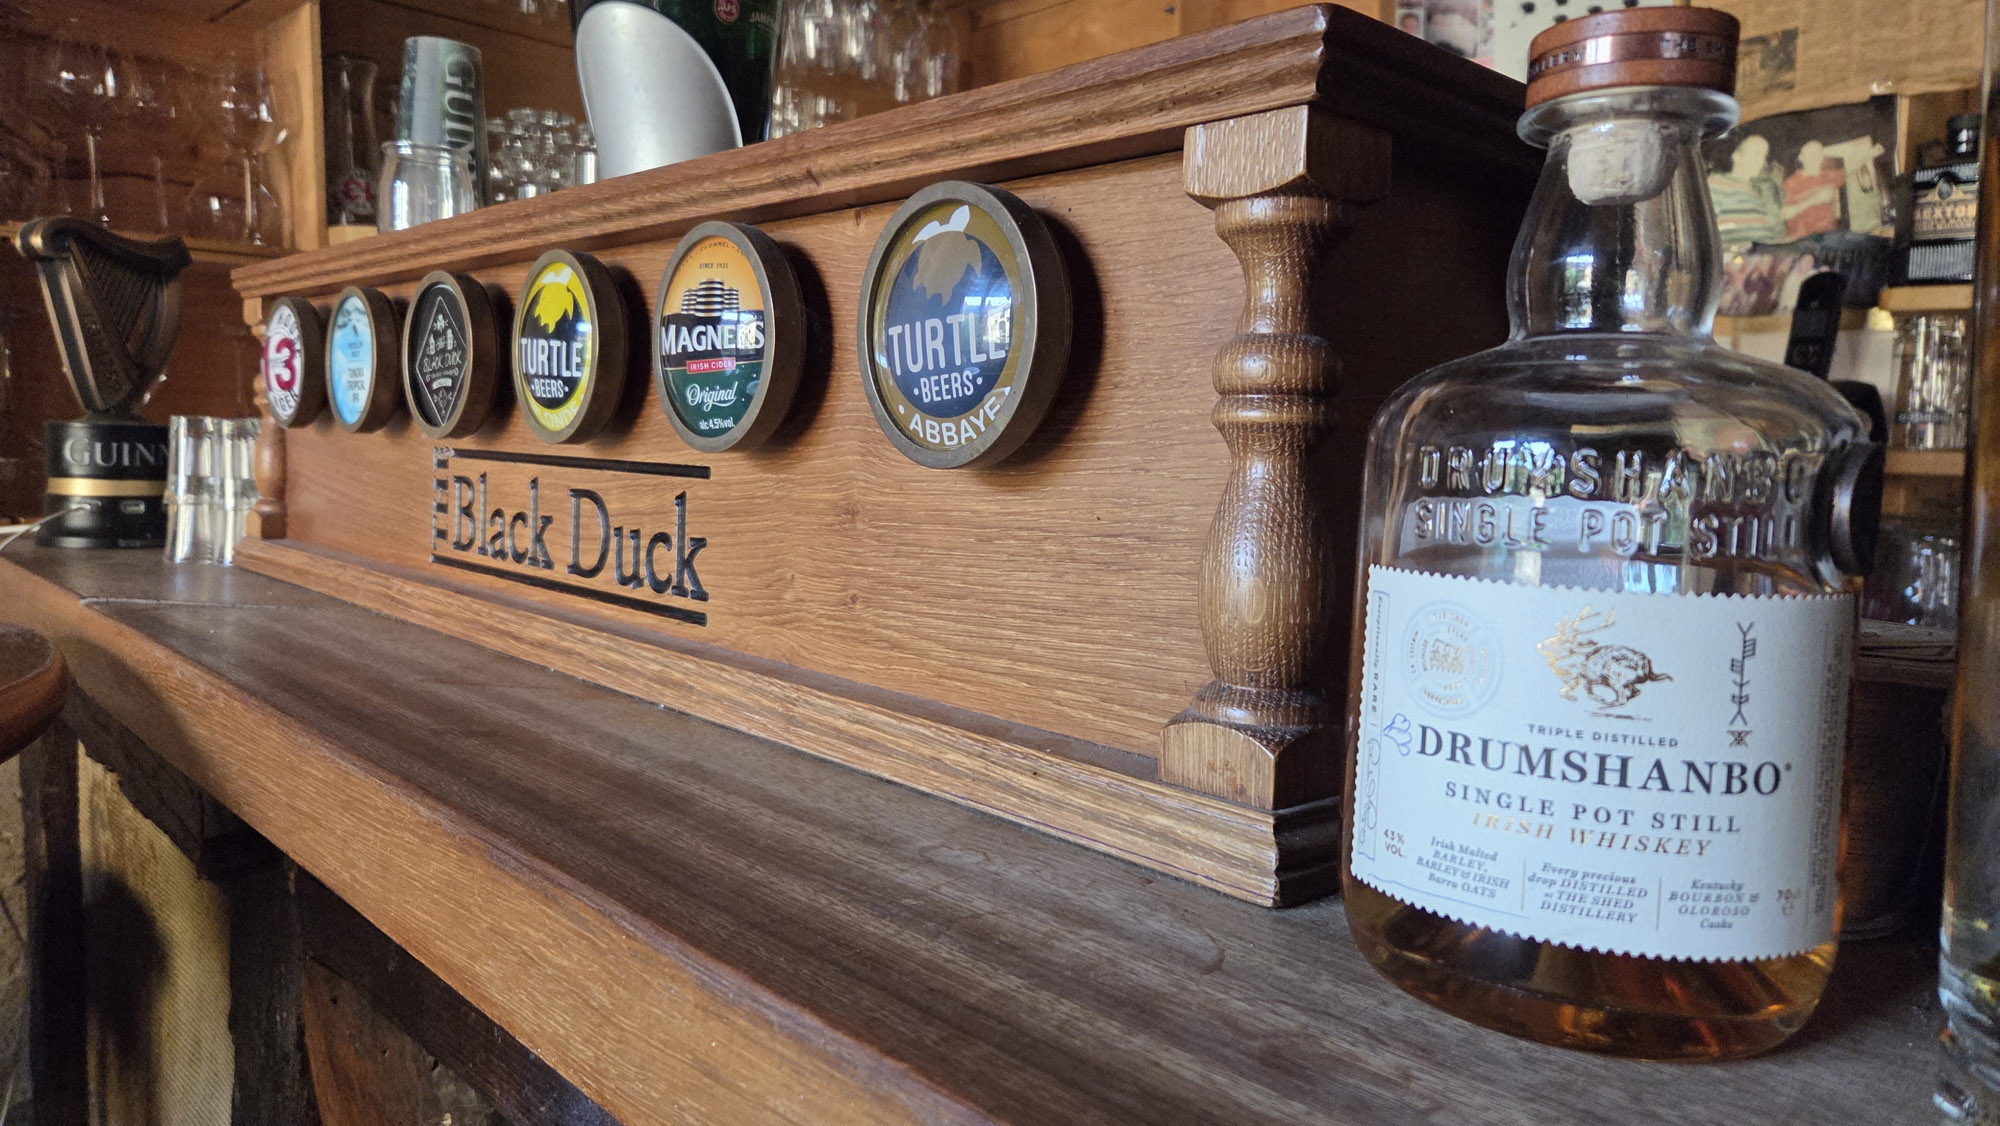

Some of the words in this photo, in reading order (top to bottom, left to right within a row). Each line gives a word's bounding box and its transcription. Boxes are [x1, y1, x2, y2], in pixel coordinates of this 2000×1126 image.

[699, 262, 714, 270] SINCE
[660, 321, 766, 356] MAGNERS
[888, 312, 1007, 376] TURTLE
[520, 337, 583, 378] TURTLE
[690, 362, 710, 371] IRISH
[711, 361, 732, 369] CIDER
[533, 378, 565, 399] BEERS
[686, 381, 738, 412] Original
[920, 371, 974, 403] BEERS
[1418, 445, 1812, 505] DRUMSHANBO
[452, 471, 555, 570] Black
[566, 490, 710, 603] Duck
[1414, 500, 1551, 552] SINGLE
[1579, 507, 1668, 557] POT
[1690, 512, 1796, 560] STILL
[1371, 672, 1379, 713] RARE
[1527, 723, 1584, 739] TRIPLE
[1592, 731, 1679, 748] DISTILLED
[1416, 723, 1782, 796] DRUMSHANBO
[1445, 780, 1555, 817] SINGLE
[1572, 803, 1635, 826] POT
[1651, 811, 1742, 834] STILL
[1384, 828, 1404, 846] 43%
[1473, 811, 1556, 841] IRISH
[1569, 827, 1713, 857] WHISKEY
[1430, 835, 1455, 851] Irish
[1458, 843, 1499, 862] Malted
[1416, 855, 1461, 878] BARLEY
[1473, 871, 1511, 890] IRISH
[1527, 872, 1557, 889] drop
[1559, 878, 1649, 899] DISTILLED
[1541, 862, 1579, 880] Every
[1581, 871, 1637, 885] precious
[1461, 882, 1497, 899] OATS
[1557, 890, 1588, 904] THE
[1591, 895, 1635, 910] SHED
[1668, 890, 1744, 903] BOURBON
[1540, 900, 1638, 923] DISTILLERY
[1678, 904, 1751, 916] OLOROSO
[1700, 918, 1734, 929] Casks
